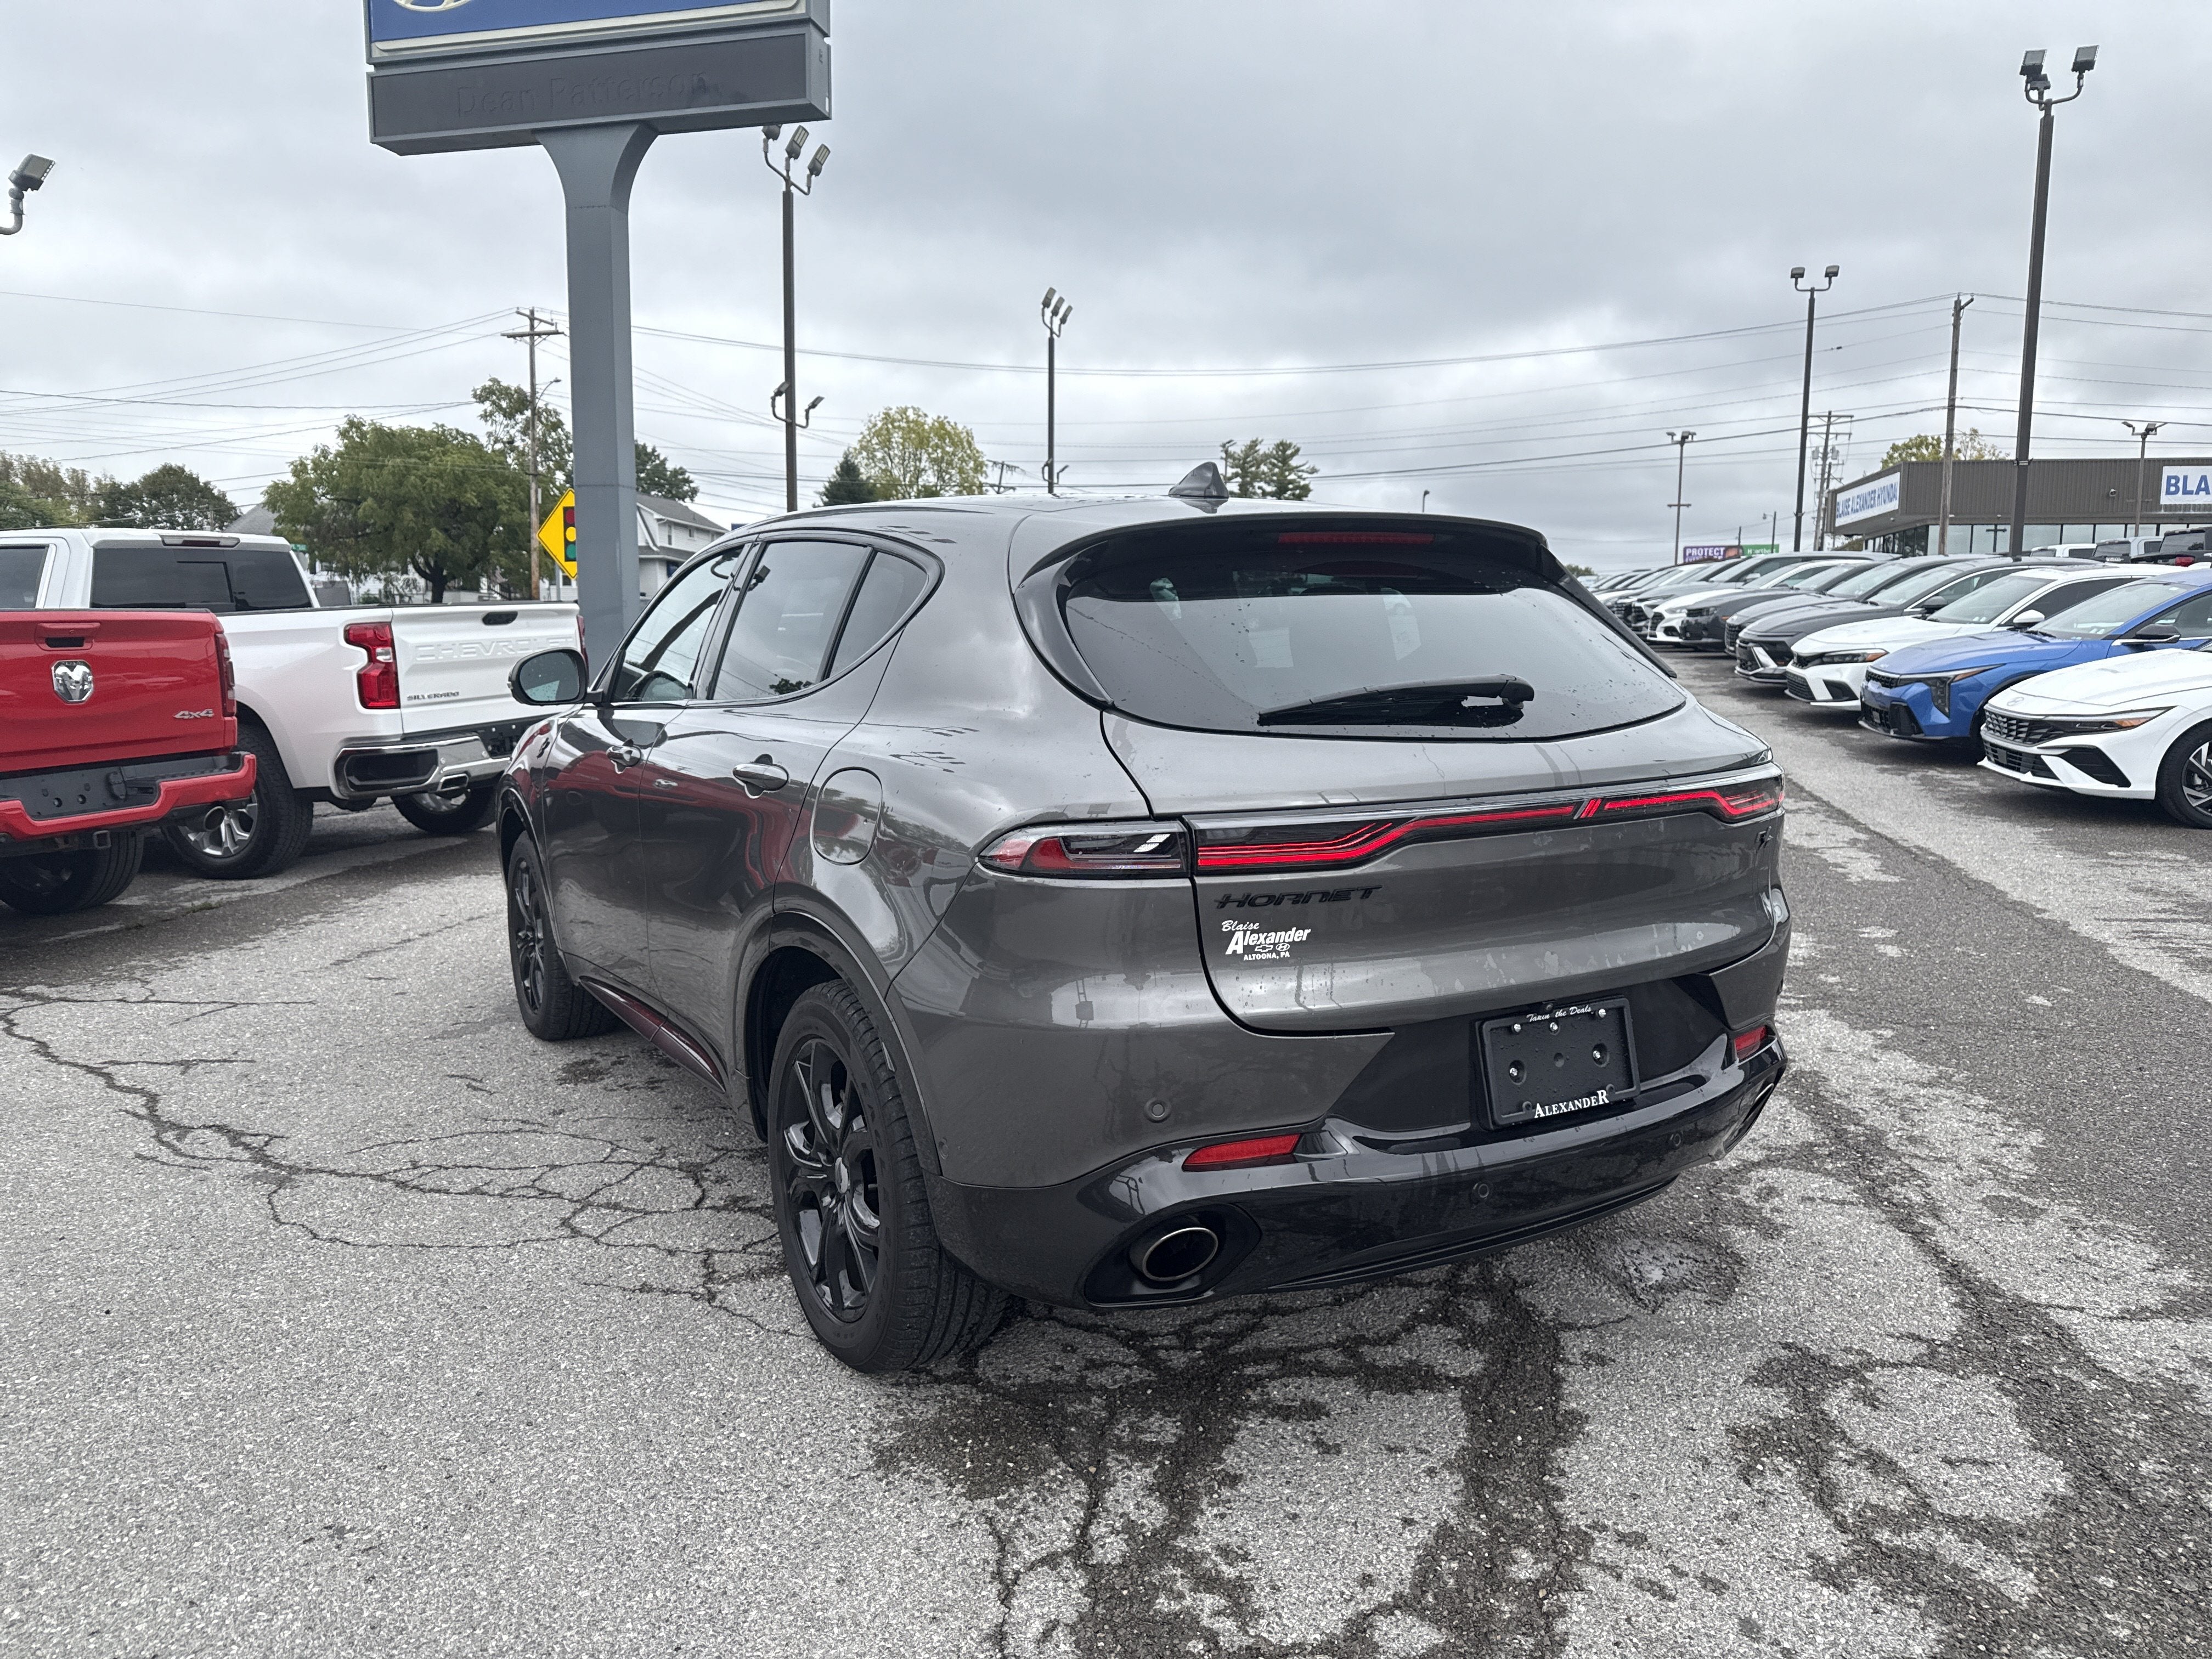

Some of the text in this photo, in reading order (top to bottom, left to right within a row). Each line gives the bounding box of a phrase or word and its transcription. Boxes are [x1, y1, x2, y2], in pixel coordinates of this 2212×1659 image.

[2165, 475, 2211, 495] BLA
[1850, 489, 1877, 514] ALEXANDER
[1877, 482, 1898, 506] HYUNDAI
[1685, 547, 1725, 556] PROTECT
[407, 691, 460, 702] SILVERADO
[1214, 884, 1383, 909] HORNET
[1221, 919, 1260, 932] Blaise
[1225, 927, 1311, 955] Alexander
[1243, 952, 1279, 961] ALTOONA,
[1555, 1009, 1567, 1018] the
